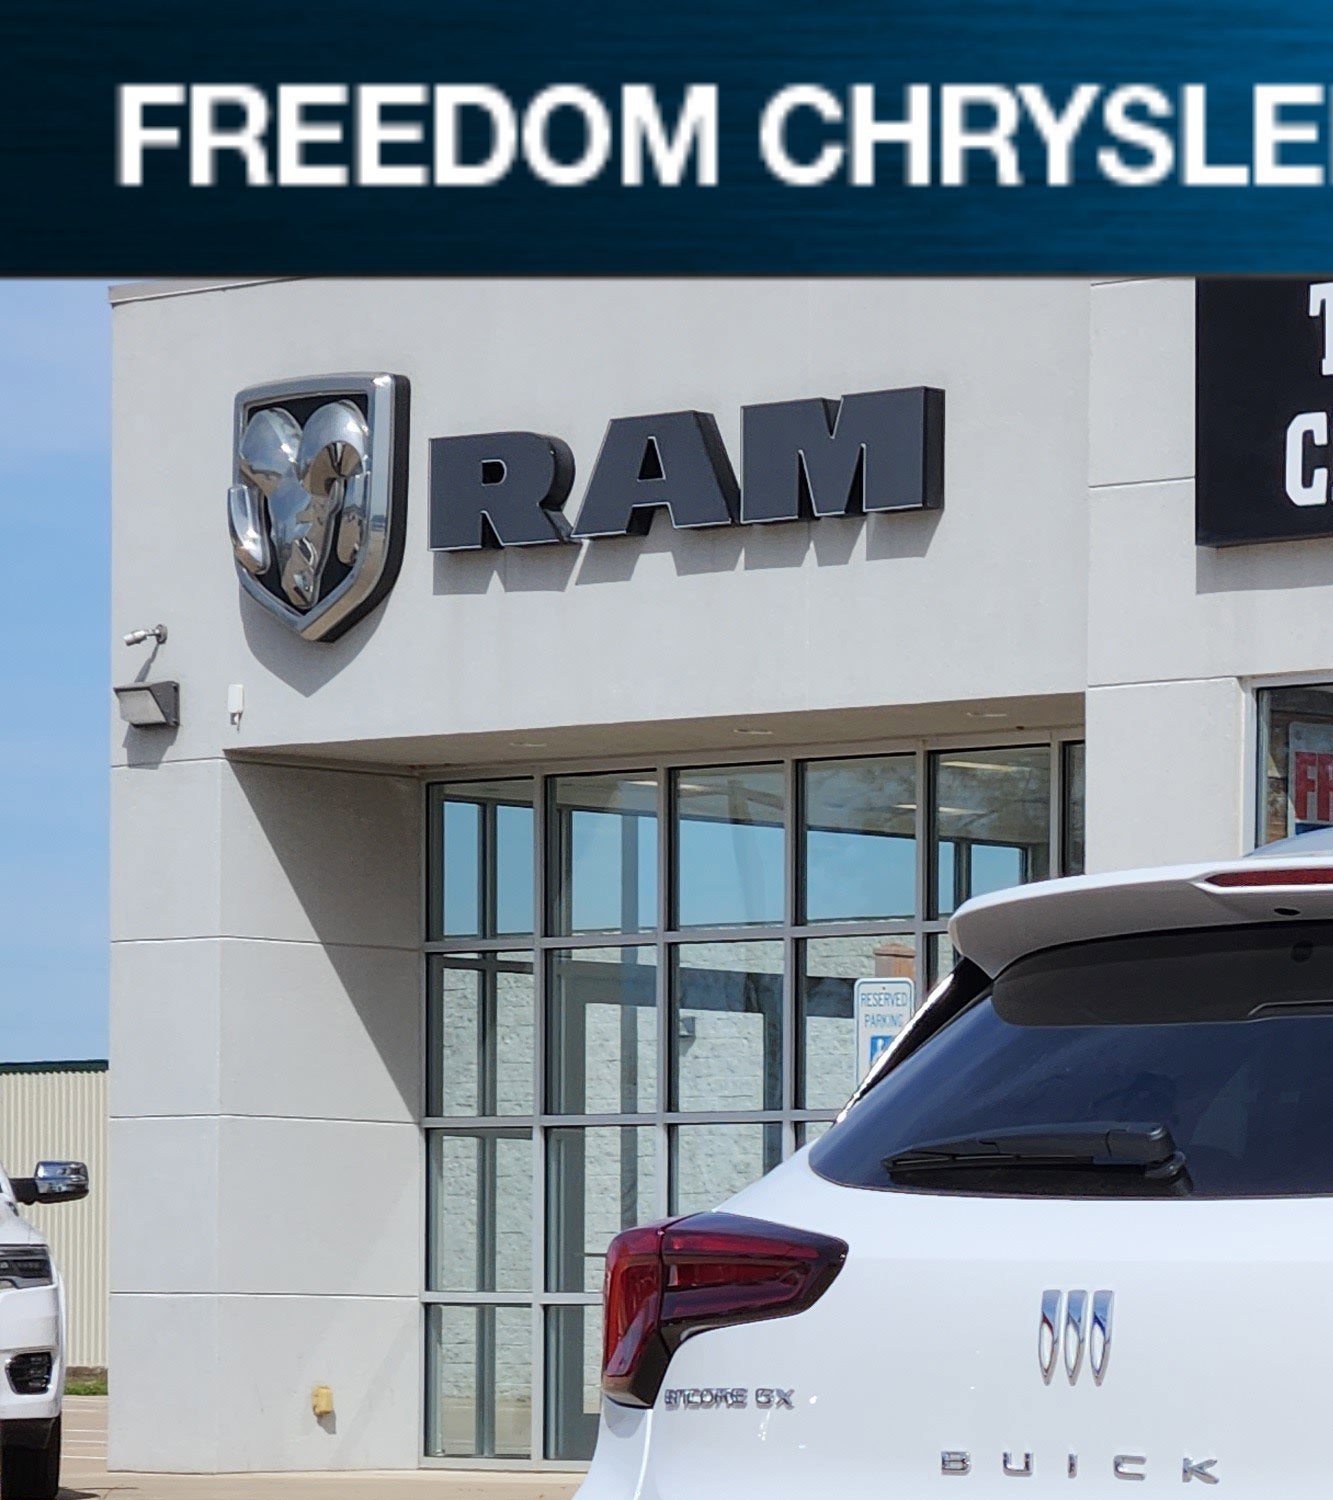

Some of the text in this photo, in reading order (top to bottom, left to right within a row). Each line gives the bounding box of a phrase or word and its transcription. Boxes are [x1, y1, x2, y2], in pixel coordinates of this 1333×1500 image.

[429, 386, 946, 551] RAM
[860, 991, 909, 1008] RESERVED
[664, 1387, 796, 1410] ENCORE GX
[940, 1450, 1220, 1485] BUICK
